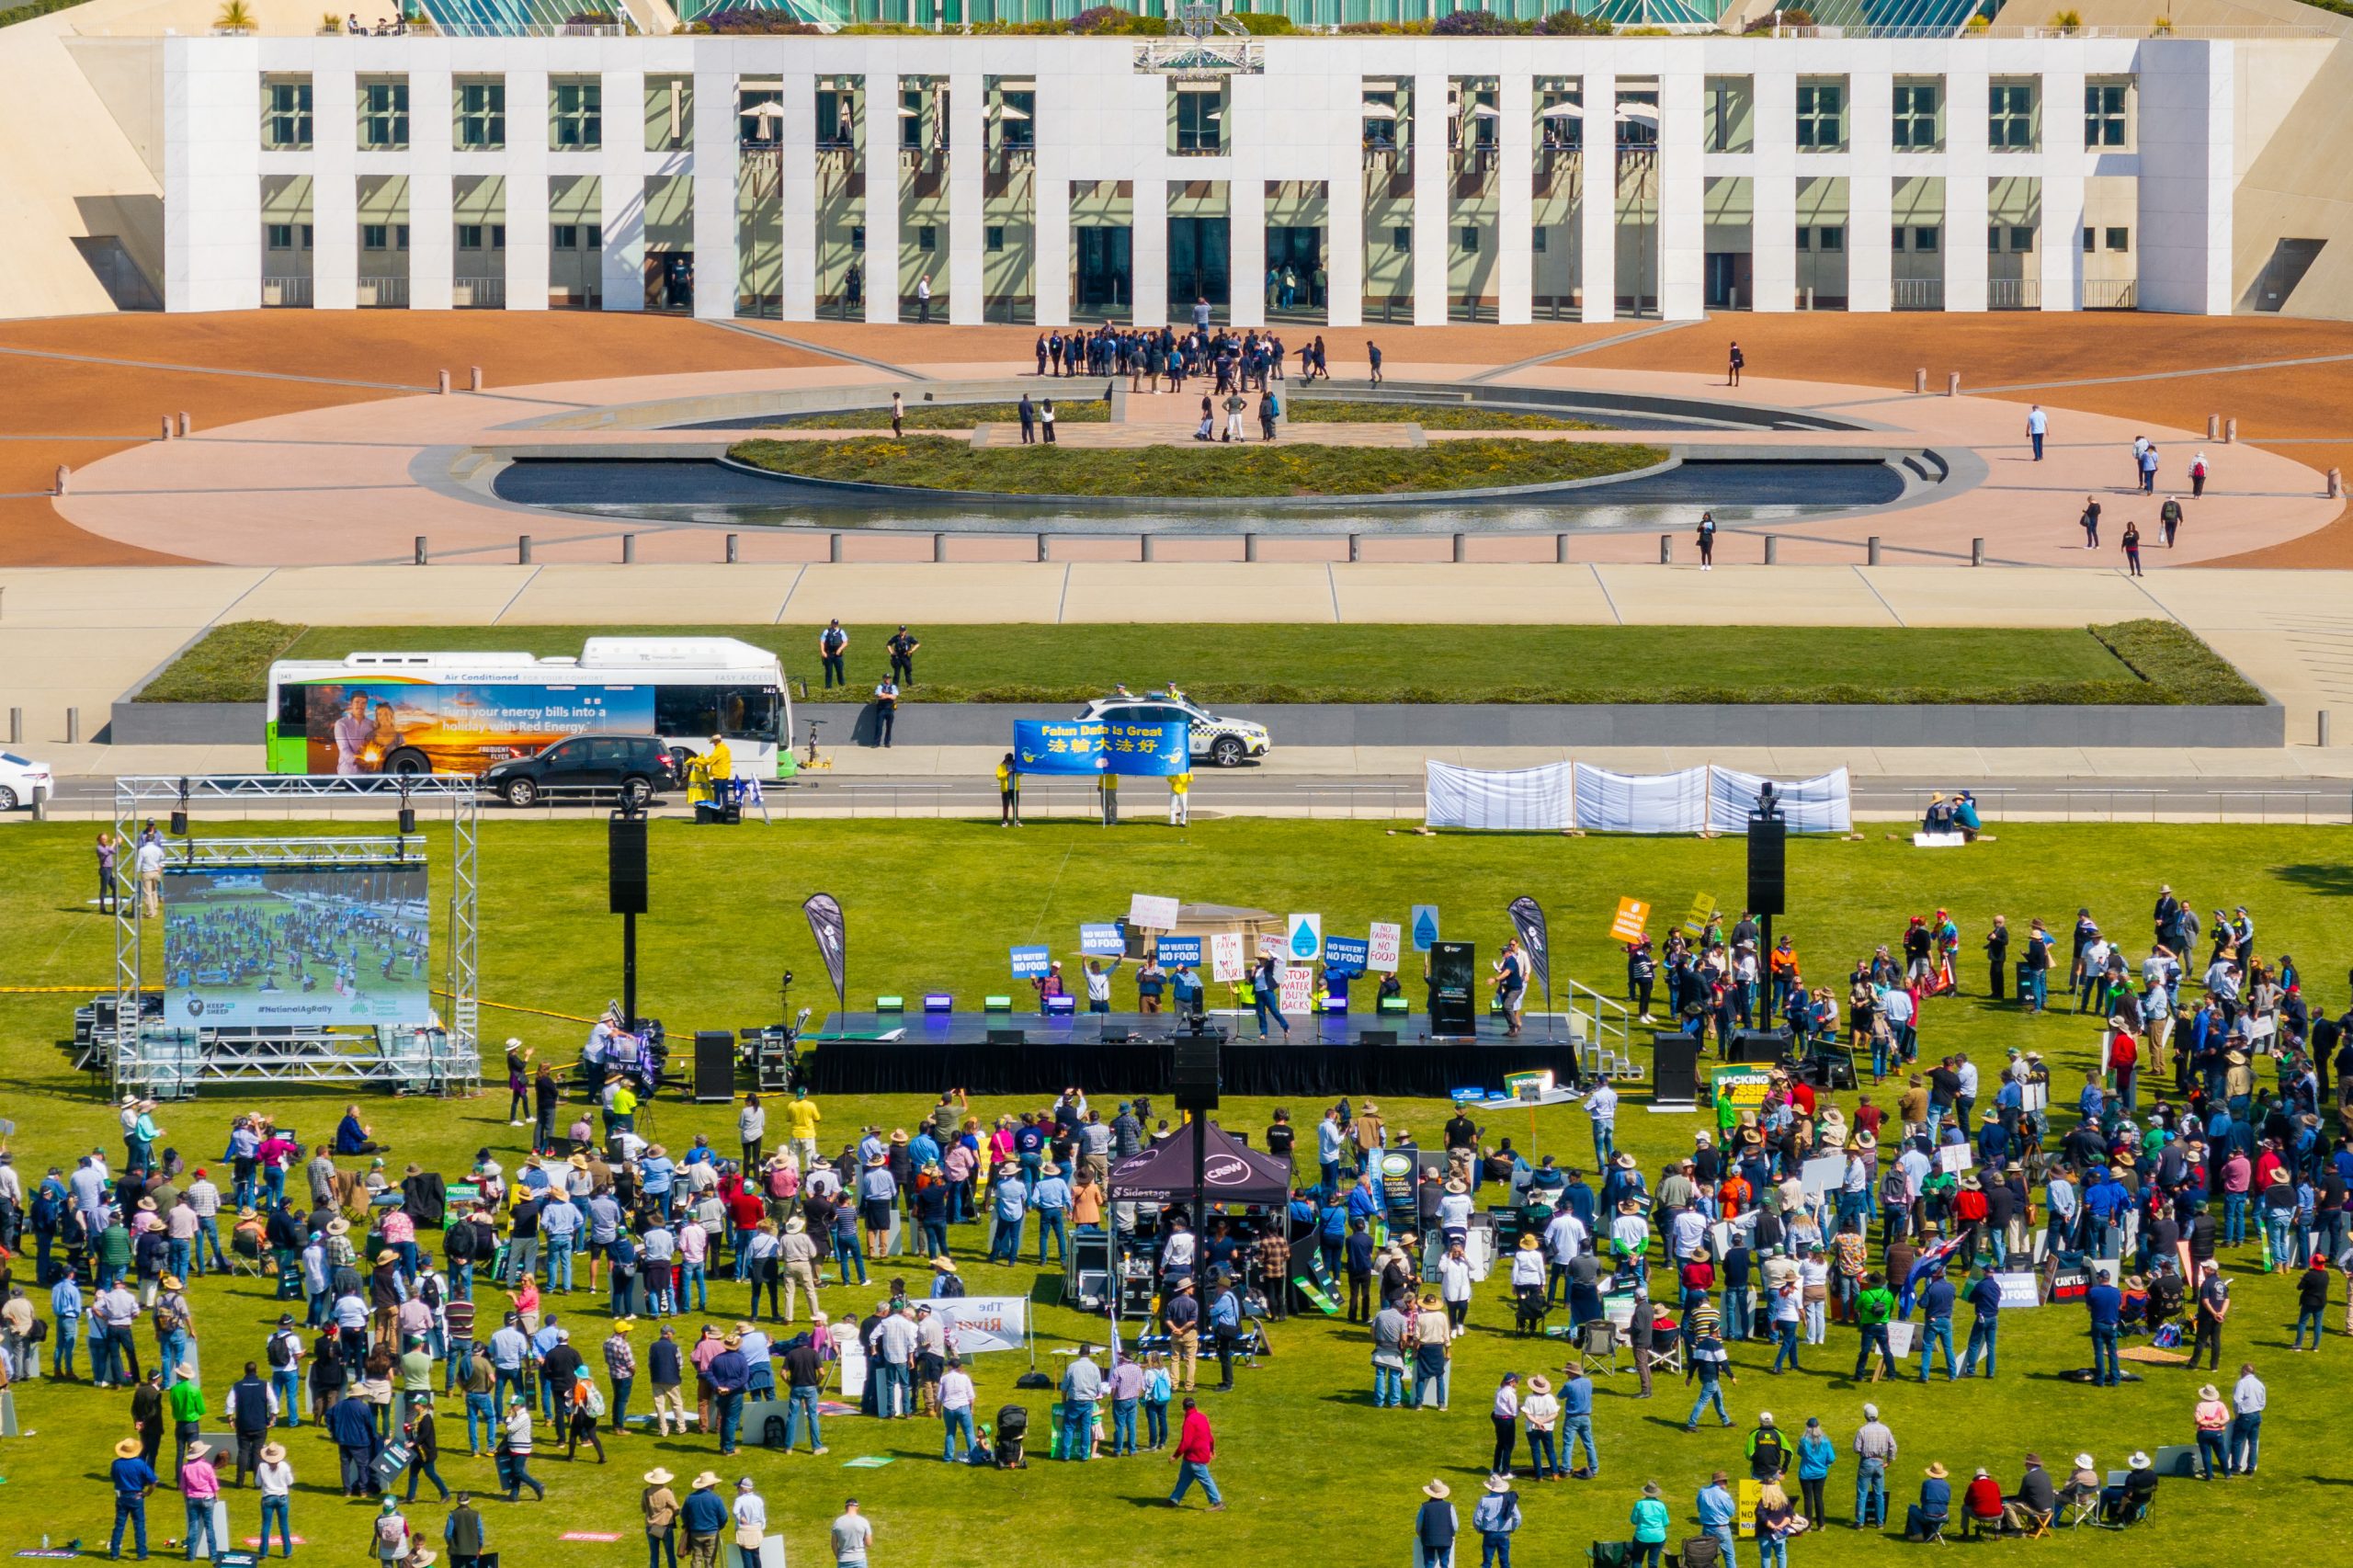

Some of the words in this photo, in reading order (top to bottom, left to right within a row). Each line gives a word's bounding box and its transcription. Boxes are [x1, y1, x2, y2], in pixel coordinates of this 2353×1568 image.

[442, 707, 468, 716] Turn
[471, 709, 499, 719] your
[501, 709, 542, 720] energy
[545, 706, 569, 717] bills
[572, 706, 596, 717] into
[598, 709, 607, 717] a
[442, 722, 484, 733] holiday
[489, 721, 516, 732] with
[518, 722, 540, 732] Red
[1041, 726, 1077, 736] Falun
[1080, 725, 1108, 735] Dafa
[1126, 726, 1163, 736] Great
[1047, 737, 1159, 754] 法輪大法好
[1083, 930, 1093, 938] NO
[1094, 930, 1121, 938] WATER?
[1380, 925, 1392, 933] NO
[1370, 931, 1399, 942] FARMERS
[1083, 939, 1097, 948] NO
[1097, 938, 1123, 948] FOOD
[1170, 943, 1199, 951] WATER?
[1216, 940, 1236, 949] FARM
[1327, 942, 1338, 950] NO
[1338, 944, 1367, 954] WATER?
[1377, 941, 1391, 951] NO
[1022, 952, 1047, 960] WATER?
[1159, 952, 1173, 961] NO
[1174, 952, 1199, 960] FOOD
[1224, 949, 1233, 958] IS
[1325, 950, 1340, 960] NO
[1340, 953, 1366, 964] FOOD
[1370, 950, 1396, 962] FOOD
[1013, 962, 1027, 971] NO
[1026, 961, 1048, 971] FOOD
[1284, 970, 1310, 981] STOP
[1280, 981, 1309, 991] WATER
[1285, 991, 1304, 1000] BUY
[257, 1005, 333, 1015] #NationalAgRally
[1281, 1000, 1310, 1011] BACKS
[1718, 1074, 1769, 1085] BACKING
[1122, 1187, 1171, 1199] Sidestage
[2006, 1290, 2037, 1301] FOOD
[1605, 1300, 1634, 1308] PROTEC
[1741, 1510, 1754, 1518] NO
